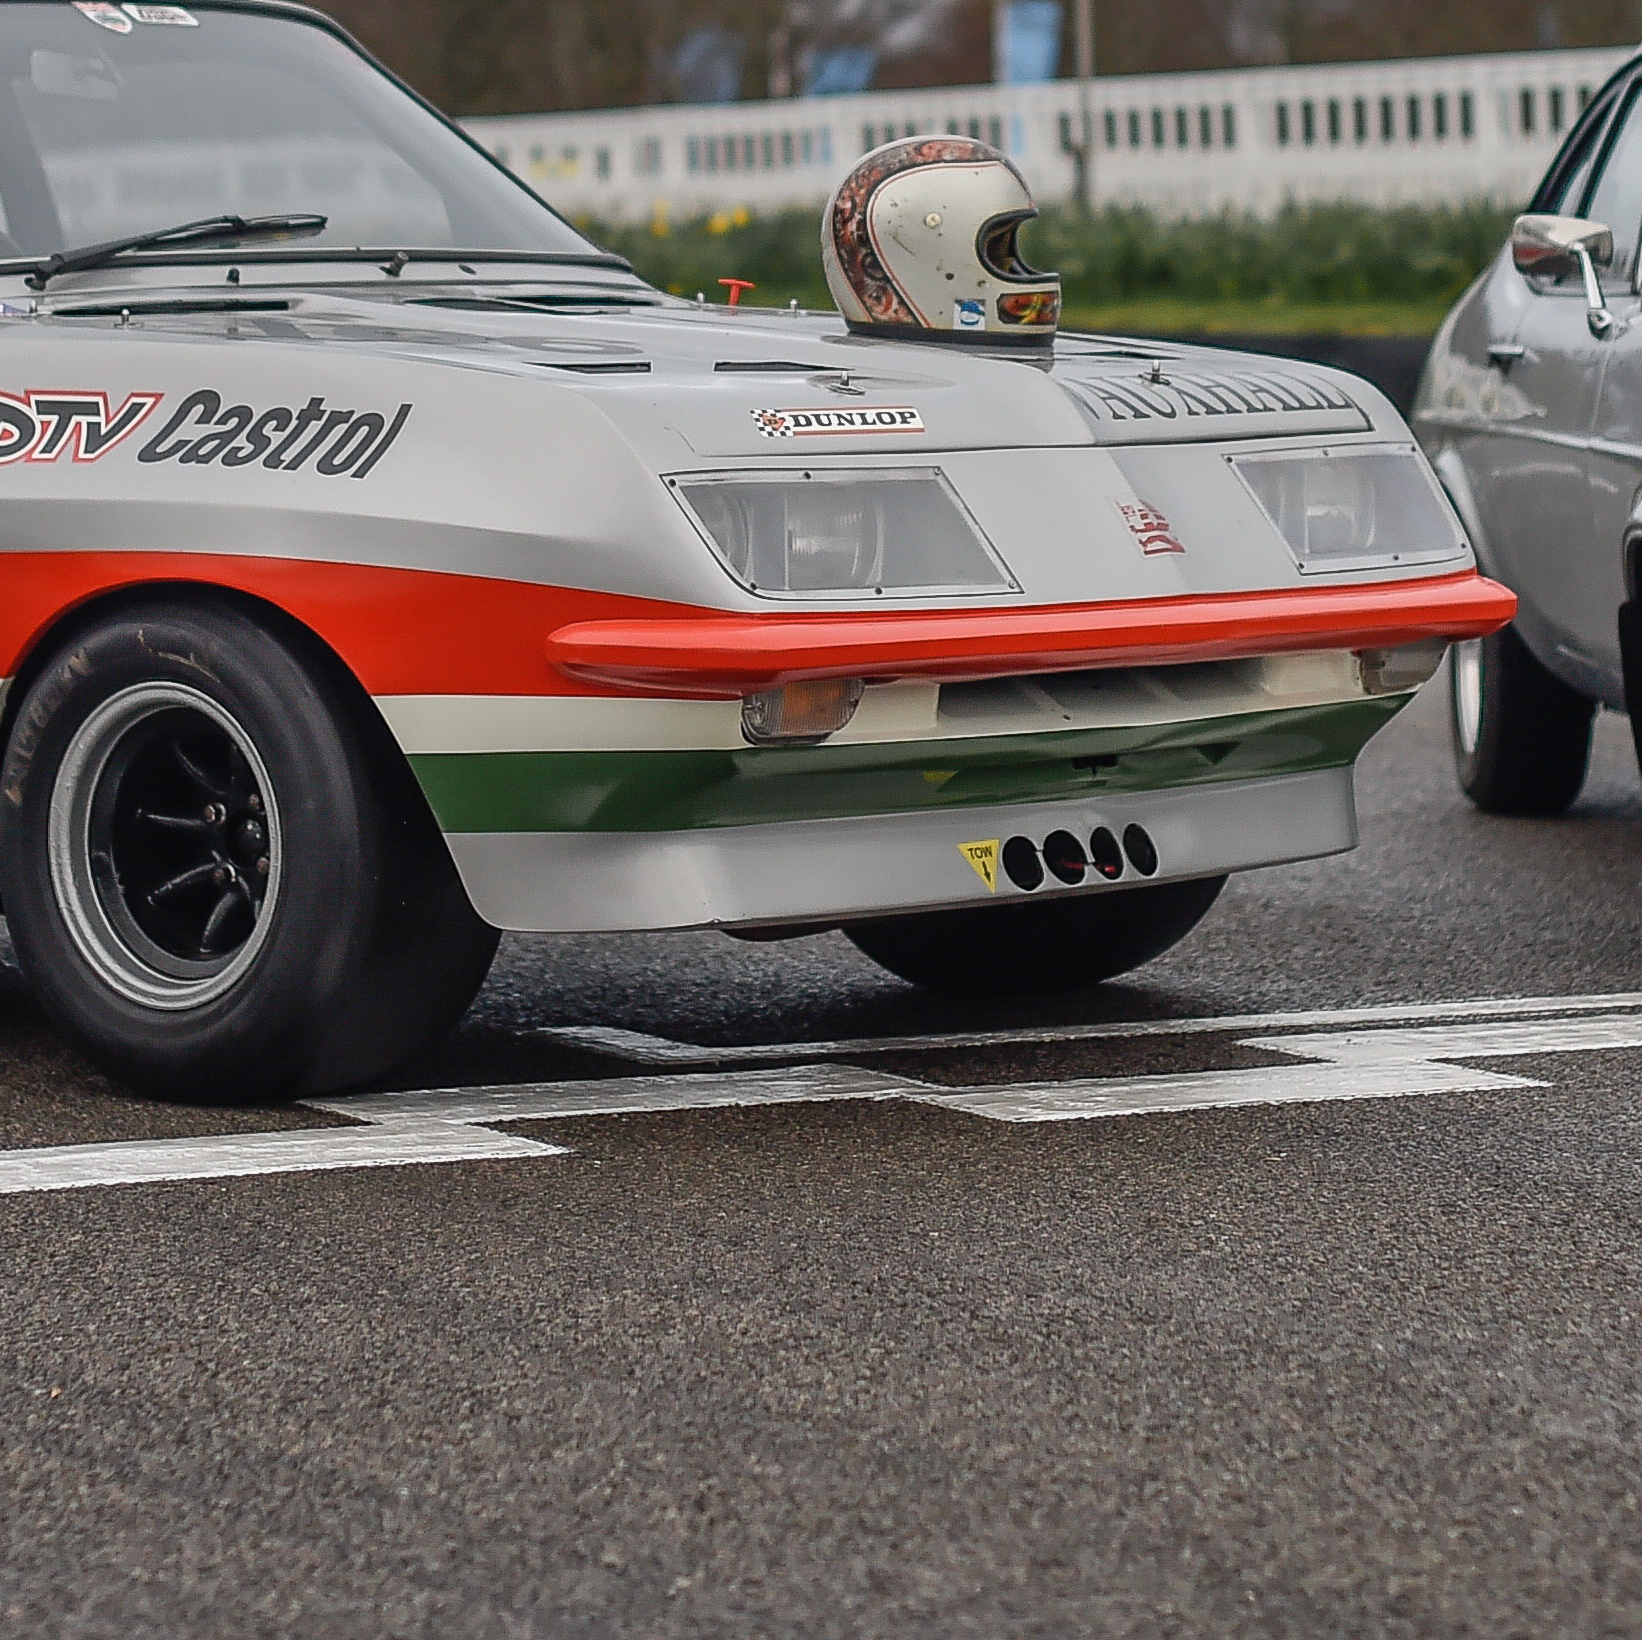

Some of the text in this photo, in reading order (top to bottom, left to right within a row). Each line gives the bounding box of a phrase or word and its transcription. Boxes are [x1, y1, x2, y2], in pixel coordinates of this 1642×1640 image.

[789, 411, 917, 428] DUNLOP
[136, 388, 413, 480] Castrol
[967, 846, 992, 860] TOW
